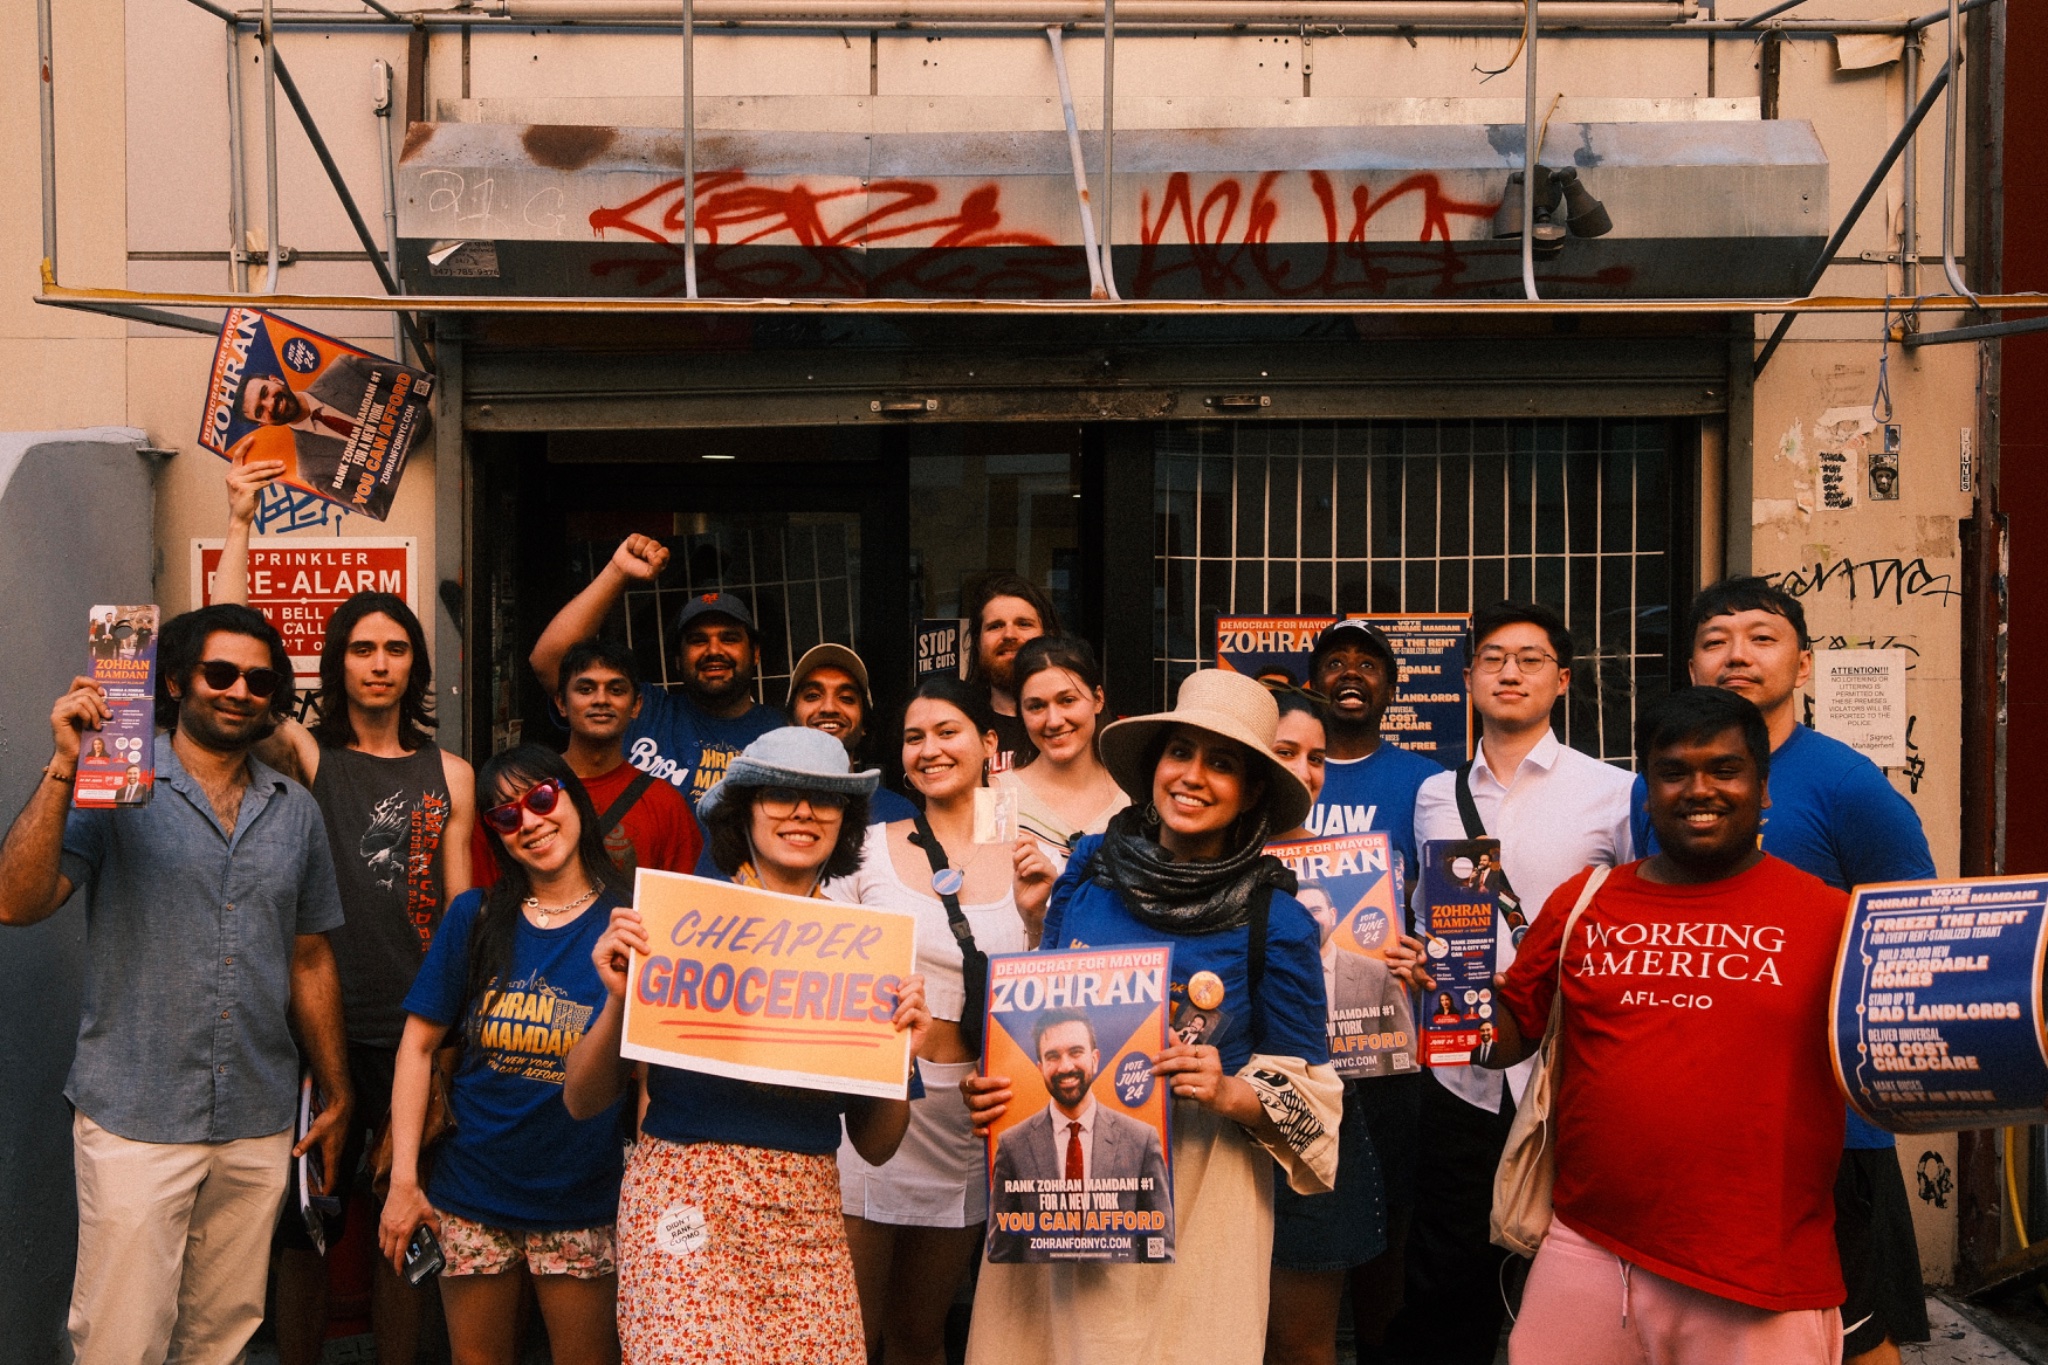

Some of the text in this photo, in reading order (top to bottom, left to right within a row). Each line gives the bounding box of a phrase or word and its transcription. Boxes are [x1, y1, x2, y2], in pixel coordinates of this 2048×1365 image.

[294, 340, 306, 372] JUNE
[303, 350, 315, 369] 24
[203, 307, 241, 441] DEMOCRAT FOR MAYOR
[209, 307, 262, 452] ZOHRAN
[368, 402, 385, 425] YORK
[332, 463, 349, 490] RANK
[342, 426, 362, 463] ZOHRAN
[356, 383, 378, 428] MAMDANI
[352, 472, 376, 504] YOU
[365, 435, 390, 473] CAN
[378, 372, 412, 437] AFFORD
[361, 424, 377, 444] NEW
[380, 405, 416, 485] ZOHRANFORNYC.COM
[352, 450, 366, 467] FOR
[208, 570, 400, 594] FE-ALARM
[282, 607, 324, 620] BELL
[283, 622, 326, 635] CALL
[1221, 621, 1296, 629] DEMOCRAT FOR
[919, 628, 956, 658] STOP
[1218, 631, 1321, 653] ZOHRA
[1405, 638, 1427, 648] THE
[1428, 638, 1457, 648] RENT
[96, 659, 150, 670] ZOHRAN
[918, 653, 955, 673] THE CUTS
[1398, 665, 1441, 675] RDABLE
[1831, 667, 1889, 675] ATTENTION!!!
[95, 671, 148, 680] MAMDANI
[1396, 693, 1460, 703] LANDLORDS
[1380, 722, 1432, 730] HILDCARE
[1389, 714, 1418, 722] COST
[1410, 742, 1437, 751] FREE
[1305, 803, 1377, 836] UAW
[1305, 837, 1383, 854] FOR MAYOR
[1281, 847, 1388, 881] HRAN
[1866, 890, 2039, 911] ZOHRAN KWAME MAMDANI
[1931, 888, 1971, 897] VOTE
[1360, 912, 1377, 922] VOTE
[1431, 903, 1492, 918] ZOHRAN
[1354, 918, 1385, 934] JUNE
[1432, 917, 1491, 929] MAMDANI
[1873, 910, 2028, 932] FREEZE THE RENT
[670, 909, 883, 960] CHEAPER
[1363, 931, 1380, 945] 24
[1586, 922, 1786, 952] WORKING
[1870, 925, 2003, 945] FOR EVERY RENT-STABILIZED TENANT
[1878, 948, 1899, 960] BUILD
[1932, 945, 1950, 958] NEW
[996, 953, 1163, 976] DEMOCRAT FOR MAYOR
[1575, 950, 1783, 986] AMERICA
[1872, 955, 1990, 975] AFFORDABLE
[1871, 972, 1934, 989] HOMES
[637, 955, 901, 1024] GROCERIES
[990, 967, 1165, 1013] ZOHRAN
[1620, 991, 1713, 1009] AFL-CIO
[1868, 992, 1915, 1006] STAND UP TO
[1329, 1005, 1394, 1021] MAMDANI #1
[1868, 1002, 2021, 1022] BAD LANDLORDS
[1338, 1020, 1363, 1035] YORK
[1868, 1028, 1898, 1042] DELIVER
[480, 1020, 583, 1057] MAMDAN
[1333, 1031, 1408, 1053] AFFORD
[1870, 1042, 1949, 1057] NO COST
[503, 1055, 528, 1065] NEW
[529, 1057, 558, 1069] YORK
[1124, 1060, 1144, 1072] VOTE
[1873, 1055, 1981, 1072] CHILDCARE
[522, 1067, 566, 1081] AFFORD
[1116, 1070, 1151, 1087] JUNE
[1124, 1086, 1144, 1101] 24
[1004, 1177, 1154, 1193] RANK ZOHRAN MAMDANI #1
[1040, 1192, 1119, 1211] FOR A NEW YORK
[997, 1211, 1165, 1232] YOU CAN AFFORD
[1030, 1237, 1132, 1250] ZOHRANFORNYC.COM
